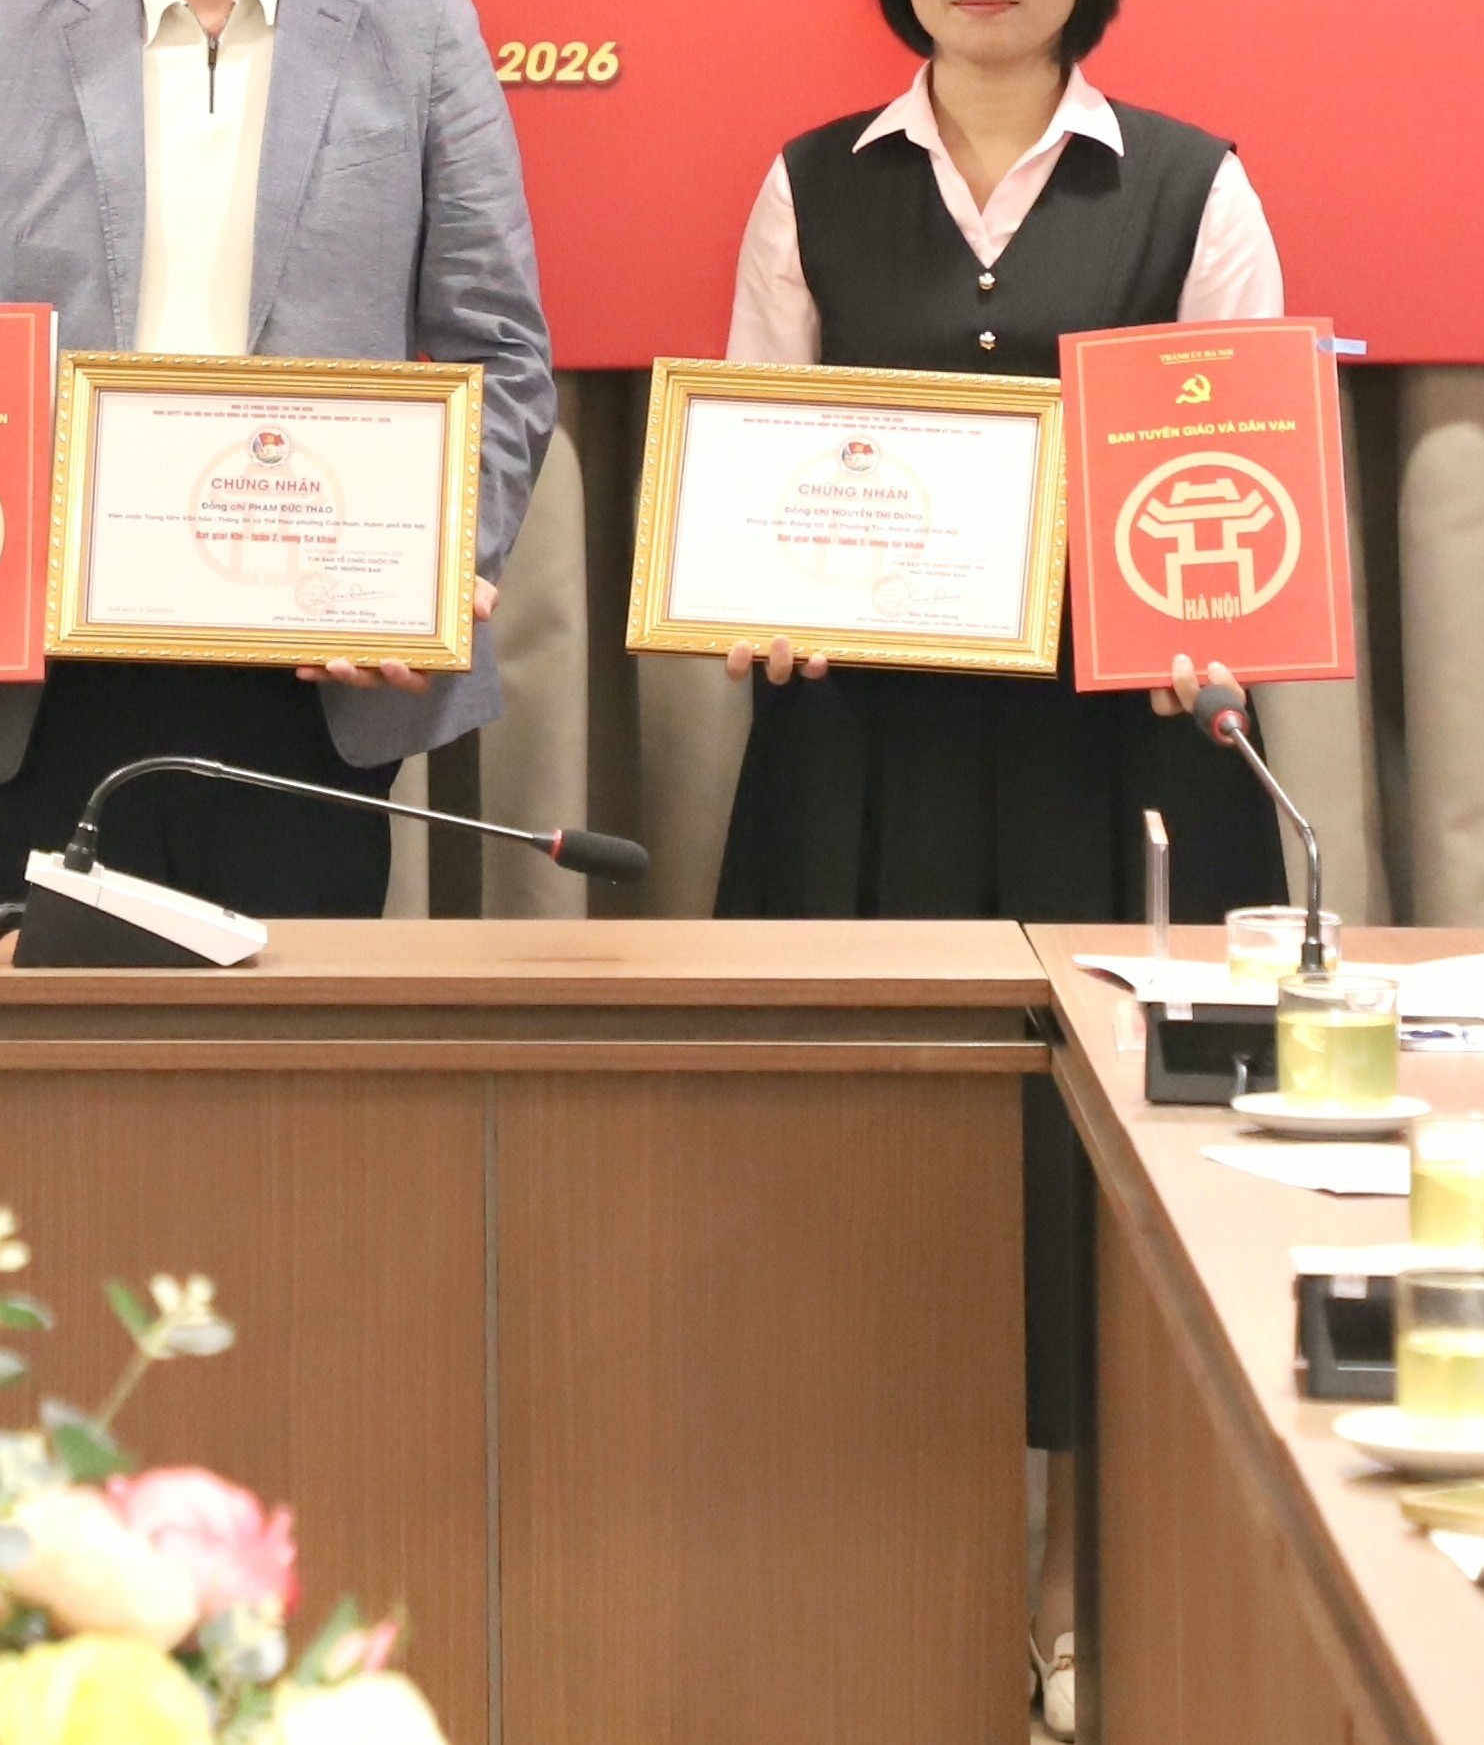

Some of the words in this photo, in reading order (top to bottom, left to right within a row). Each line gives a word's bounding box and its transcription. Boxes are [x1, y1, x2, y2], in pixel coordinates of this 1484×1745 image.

[495, 41, 620, 82] 2026
[1108, 433, 1135, 445] BAN
[1139, 426, 1180, 441] TUYÊN
[1183, 422, 1216, 437] GIÁO
[1219, 420, 1236, 434] VÀ
[1239, 419, 1267, 432] DÂN
[1269, 420, 1296, 433] VẬN
[211, 475, 269, 491] CHỨNG
[275, 478, 321, 496] NHẬN
[798, 481, 857, 497] CHỨNG
[863, 485, 909, 501] NHẬN
[1185, 593, 1209, 620] HÀ
[1211, 592, 1240, 624] NỘI
